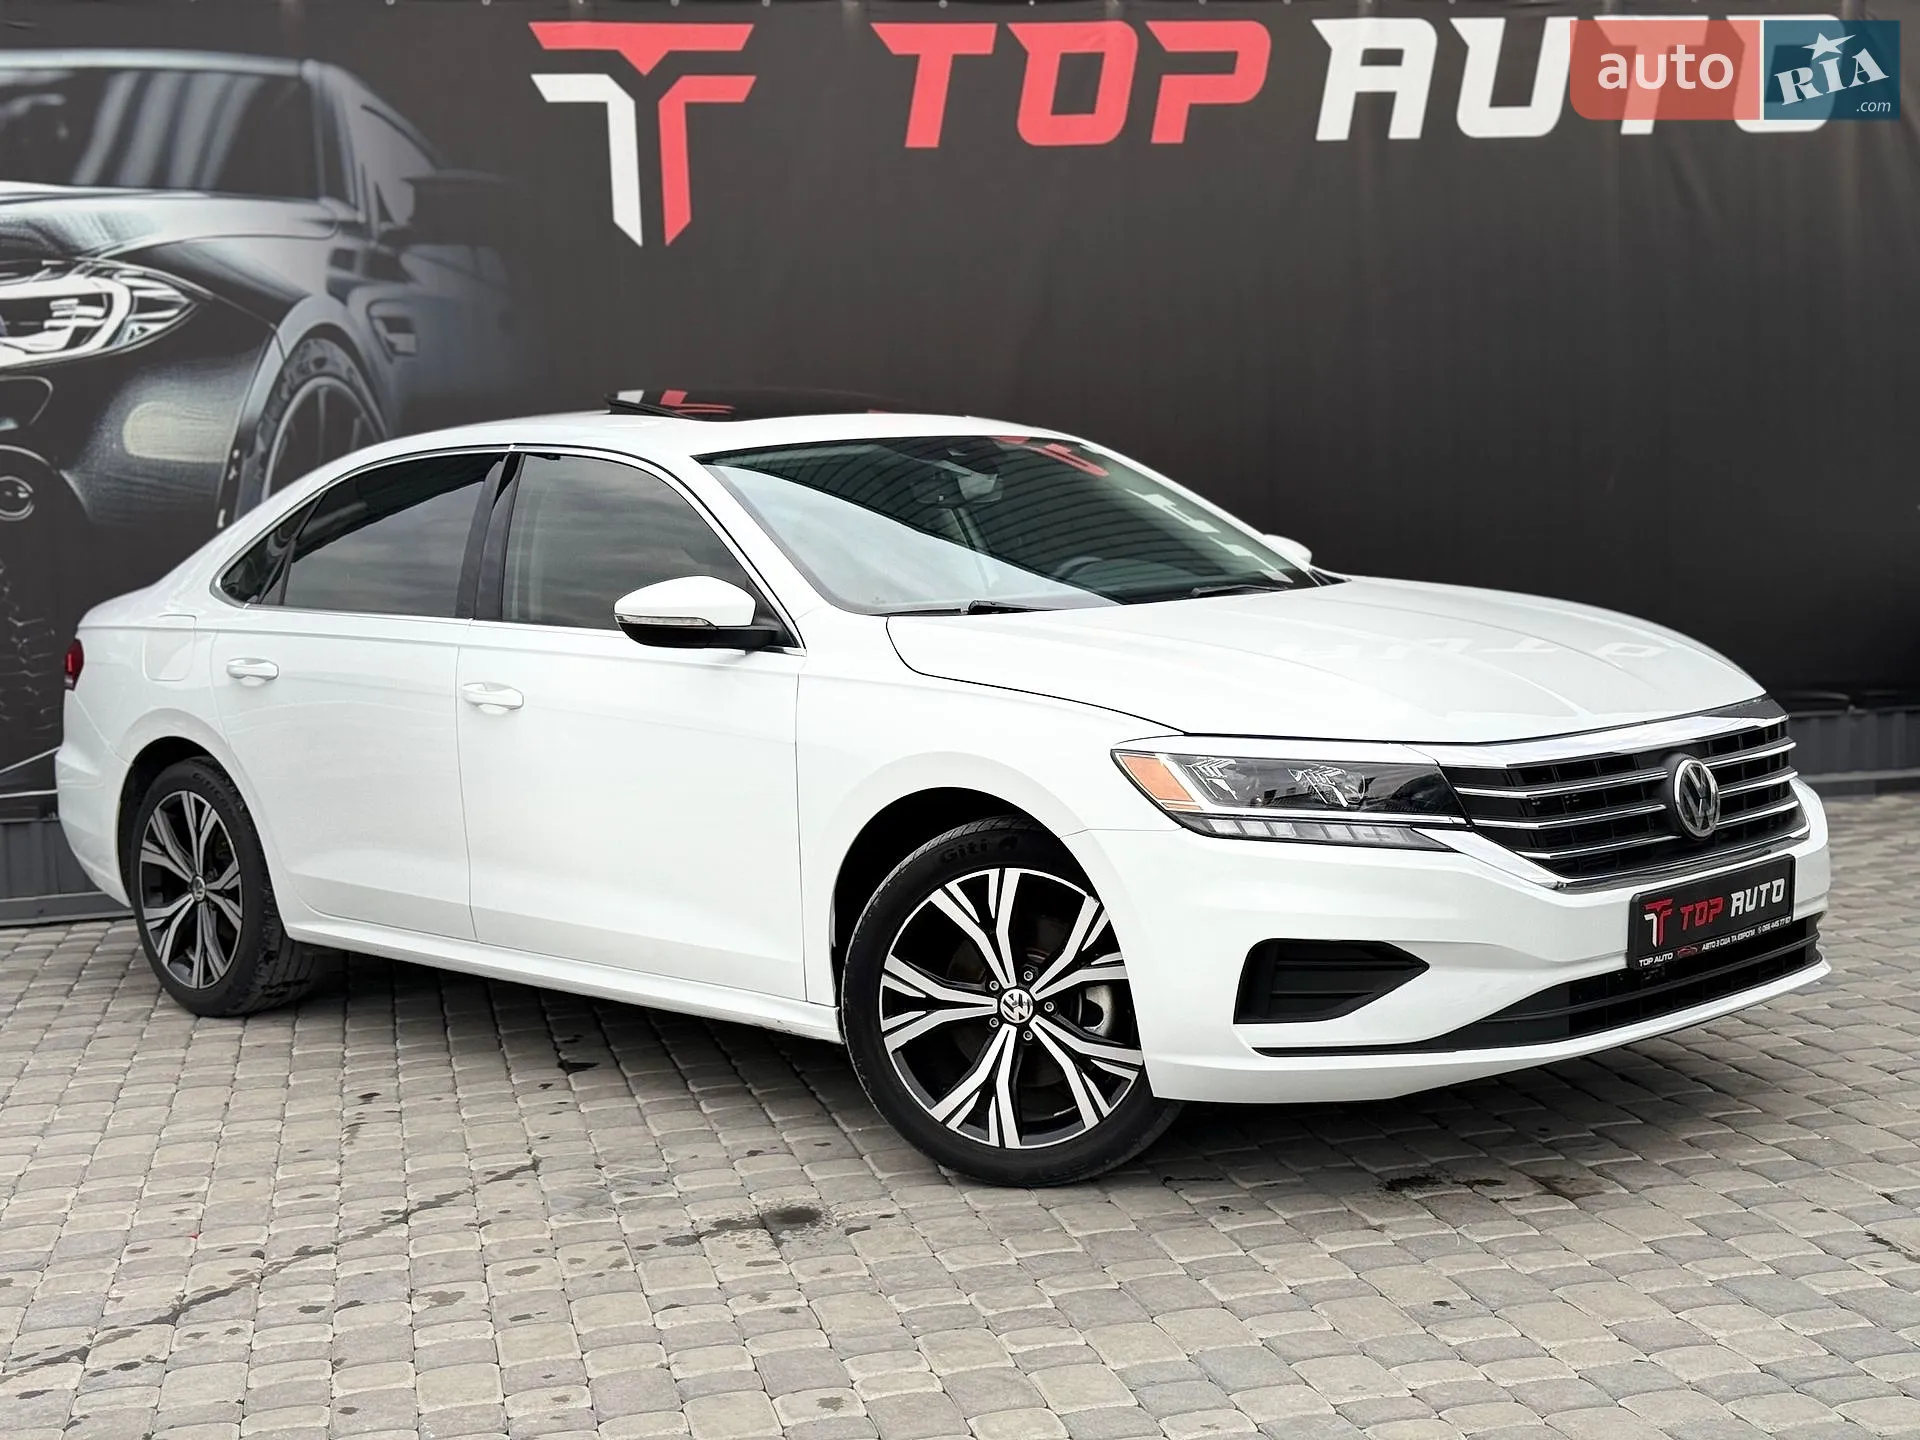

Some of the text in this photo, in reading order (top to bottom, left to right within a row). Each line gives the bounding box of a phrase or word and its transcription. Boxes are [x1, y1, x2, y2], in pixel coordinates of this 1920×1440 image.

[870, 14, 1846, 148] TOP AUTO
[1679, 878, 1786, 931] TOP AUTO
[1638, 952, 1674, 967] TOP AUTO
